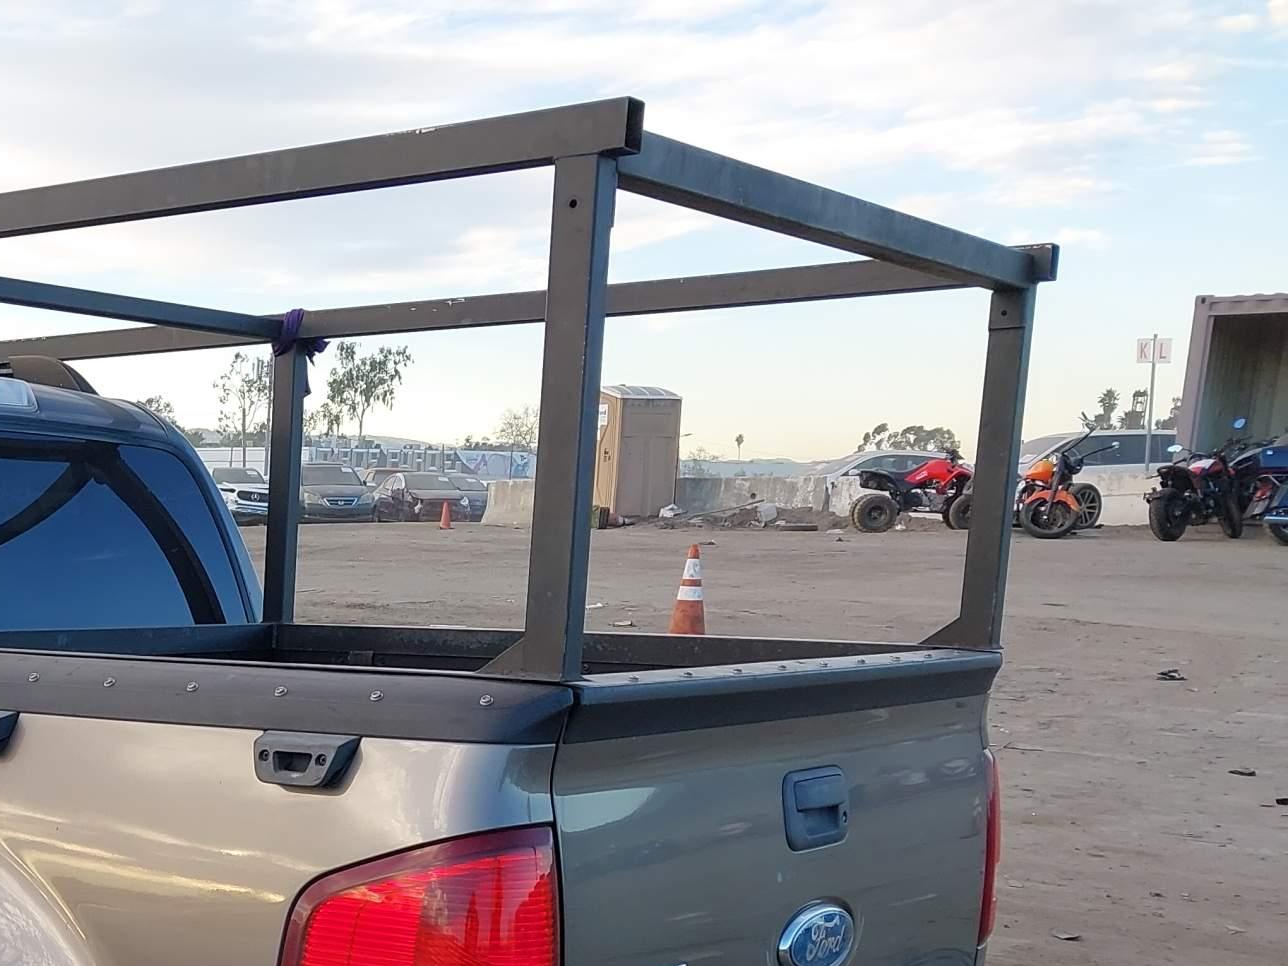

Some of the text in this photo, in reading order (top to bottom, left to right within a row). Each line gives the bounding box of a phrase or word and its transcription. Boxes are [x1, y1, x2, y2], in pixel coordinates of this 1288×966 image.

[1139, 342, 1149, 360] K
[1159, 342, 1168, 360] L
[806, 913, 847, 961] Ford
